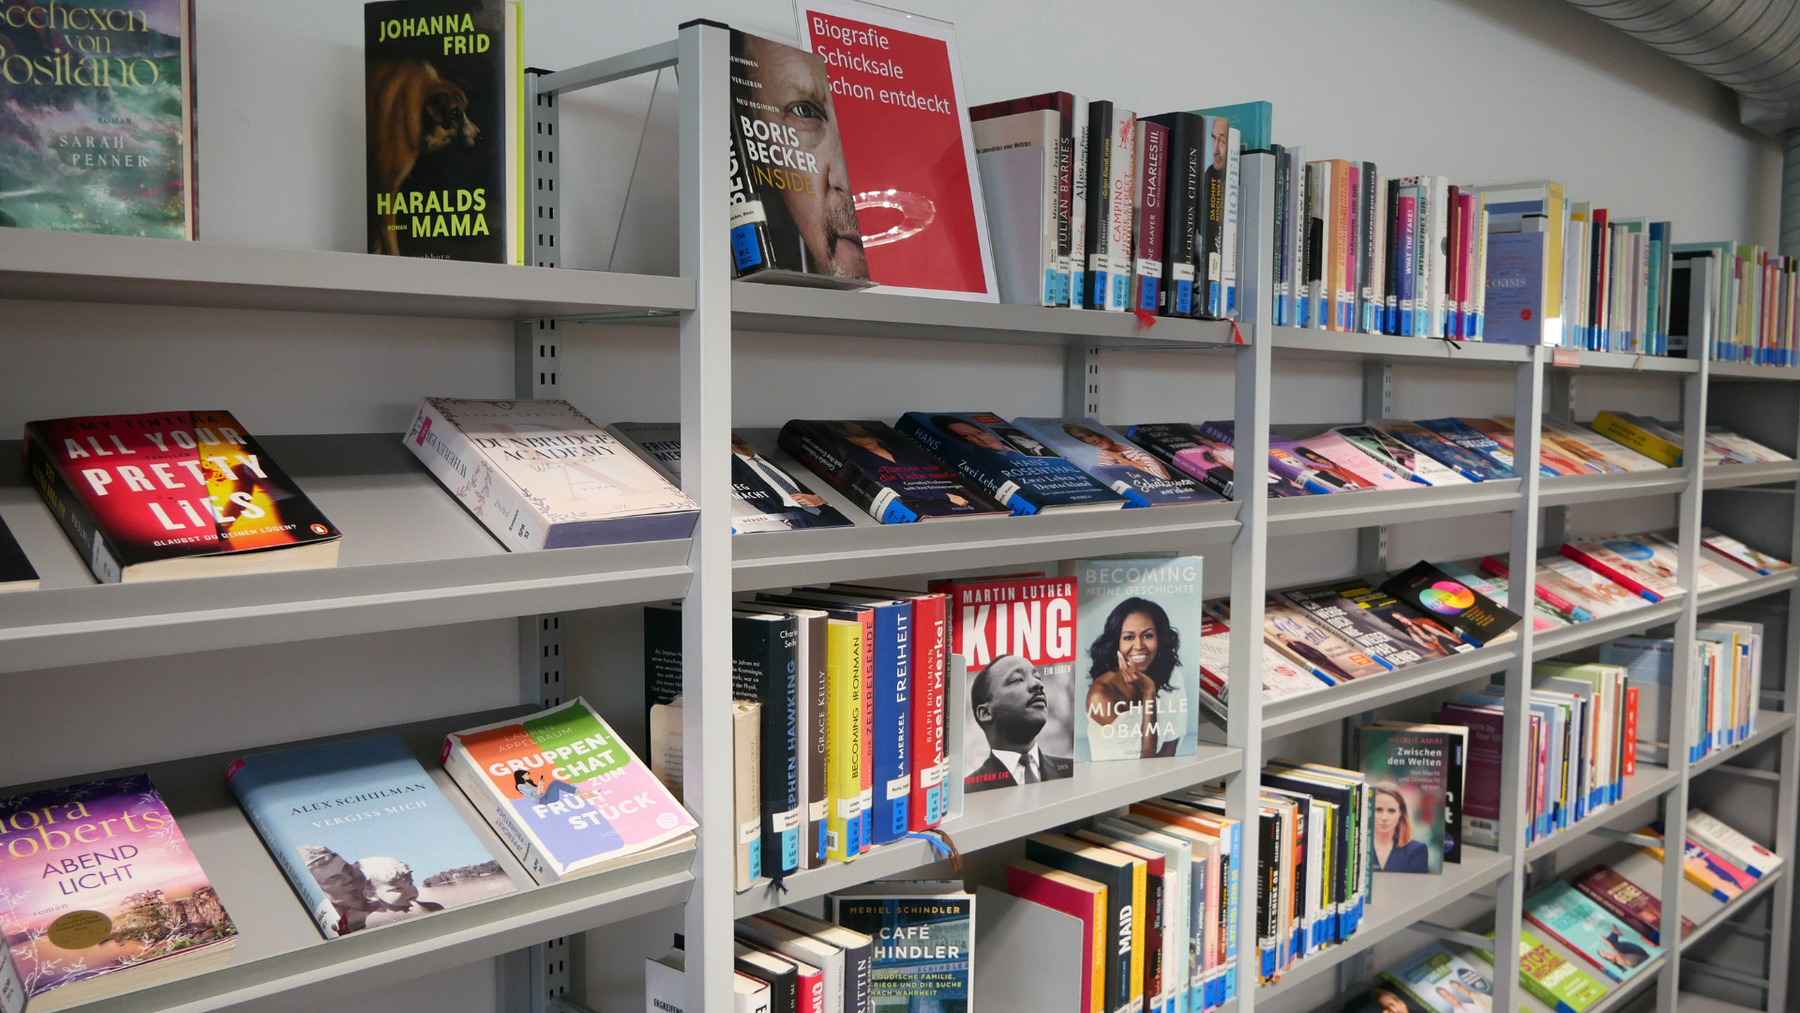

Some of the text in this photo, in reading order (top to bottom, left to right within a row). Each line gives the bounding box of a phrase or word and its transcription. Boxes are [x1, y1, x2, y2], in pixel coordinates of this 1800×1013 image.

[0, 1, 148, 32] eehexen
[379, 13, 474, 42] JOHANNA
[64, 34, 111, 53] von
[813, 17, 890, 50] Biografie
[444, 36, 490, 56] FRID
[817, 46, 904, 80] Schicksale
[731, 76, 762, 89] VERLIEREN
[736, 97, 779, 114] NEU BEGINNEN
[880, 89, 951, 114] entdeckt
[60, 135, 124, 148] SARAH
[740, 115, 800, 148] BORIS
[72, 154, 149, 167] PENNER
[746, 138, 820, 174] BECKER
[752, 164, 816, 195] INSIDE
[1076, 168, 1084, 200] Alles
[1147, 145, 1157, 207] CHARLES
[1188, 148, 1197, 199] CITIZEN
[377, 188, 486, 215] HARALDS
[1059, 137, 1070, 248] JULIAN BARNES
[1113, 179, 1122, 242] CAMPINO
[1210, 210, 1216, 220] DA
[1406, 209, 1414, 232] FAKE!
[412, 213, 490, 238] MAMA
[1492, 274, 1526, 288] oasis
[64, 416, 218, 433] AMY TINTERA
[420, 425, 428, 437] NEU
[64, 426, 247, 459] ALL YOUR
[476, 434, 616, 450] DUNBRIDGE
[914, 428, 941, 450] HANS
[145, 452, 191, 460] THRILLER
[504, 444, 616, 461] ACADEMY
[1010, 459, 1049, 467] HANS
[82, 454, 269, 496] PRETTY
[877, 464, 940, 474] »Tanzen wir
[879, 474, 891, 482] die
[894, 472, 926, 480] Liebe
[958, 460, 978, 477] Zwei
[1001, 466, 1081, 478] ROSENTHAL
[1019, 476, 1046, 484] Zwei
[1033, 480, 1091, 490] Deutschland
[148, 491, 266, 530] LIES
[72, 512, 91, 548] TINTERA
[153, 535, 200, 547] GLAUBST
[222, 528, 257, 540] DEINEN
[259, 522, 297, 535] LÜGEN?
[1086, 567, 1196, 584] BECOMING
[963, 583, 1072, 603] MARTIN LUTHER
[1086, 585, 1195, 596] MEINE GESCHICHTE
[962, 598, 1072, 666] KING
[897, 614, 908, 702] FREIHEIT
[738, 668, 763, 676] Kosmologie,
[1044, 664, 1071, 675] EIN LEBEN
[933, 620, 944, 765] Angela Merkel
[787, 660, 796, 750] HAWKING
[817, 671, 826, 753] GRACE KELLY
[1087, 698, 1188, 718] MICHELLE
[498, 727, 573, 753] APPELBAUM
[504, 723, 554, 742] LAUREN
[1101, 721, 1176, 738] OBAMA
[489, 732, 611, 777] GRUPPEN-
[1387, 757, 1441, 766] den Welten
[1397, 747, 1441, 756] Zwischen
[226, 764, 236, 779] NEU
[551, 749, 616, 780] CHAT
[998, 771, 1009, 780] EIG
[588, 767, 626, 786] ZUM
[290, 782, 426, 816] ALEX SCHULMAN
[532, 784, 612, 819] FRÜH-
[312, 800, 427, 830] VERGISS MICH
[568, 791, 658, 830] STÜCK
[494, 806, 525, 844] FRÜHSTÜCK
[600, 825, 632, 838] ROMAN
[42, 844, 138, 879] ABEND
[58, 864, 133, 895] LICHT
[278, 850, 316, 908] ALEX SCHULMAN
[33, 903, 68, 917] roman
[880, 924, 930, 940] CAFÉ
[1118, 905, 1132, 955] MAID
[874, 946, 960, 959] HINDLER
